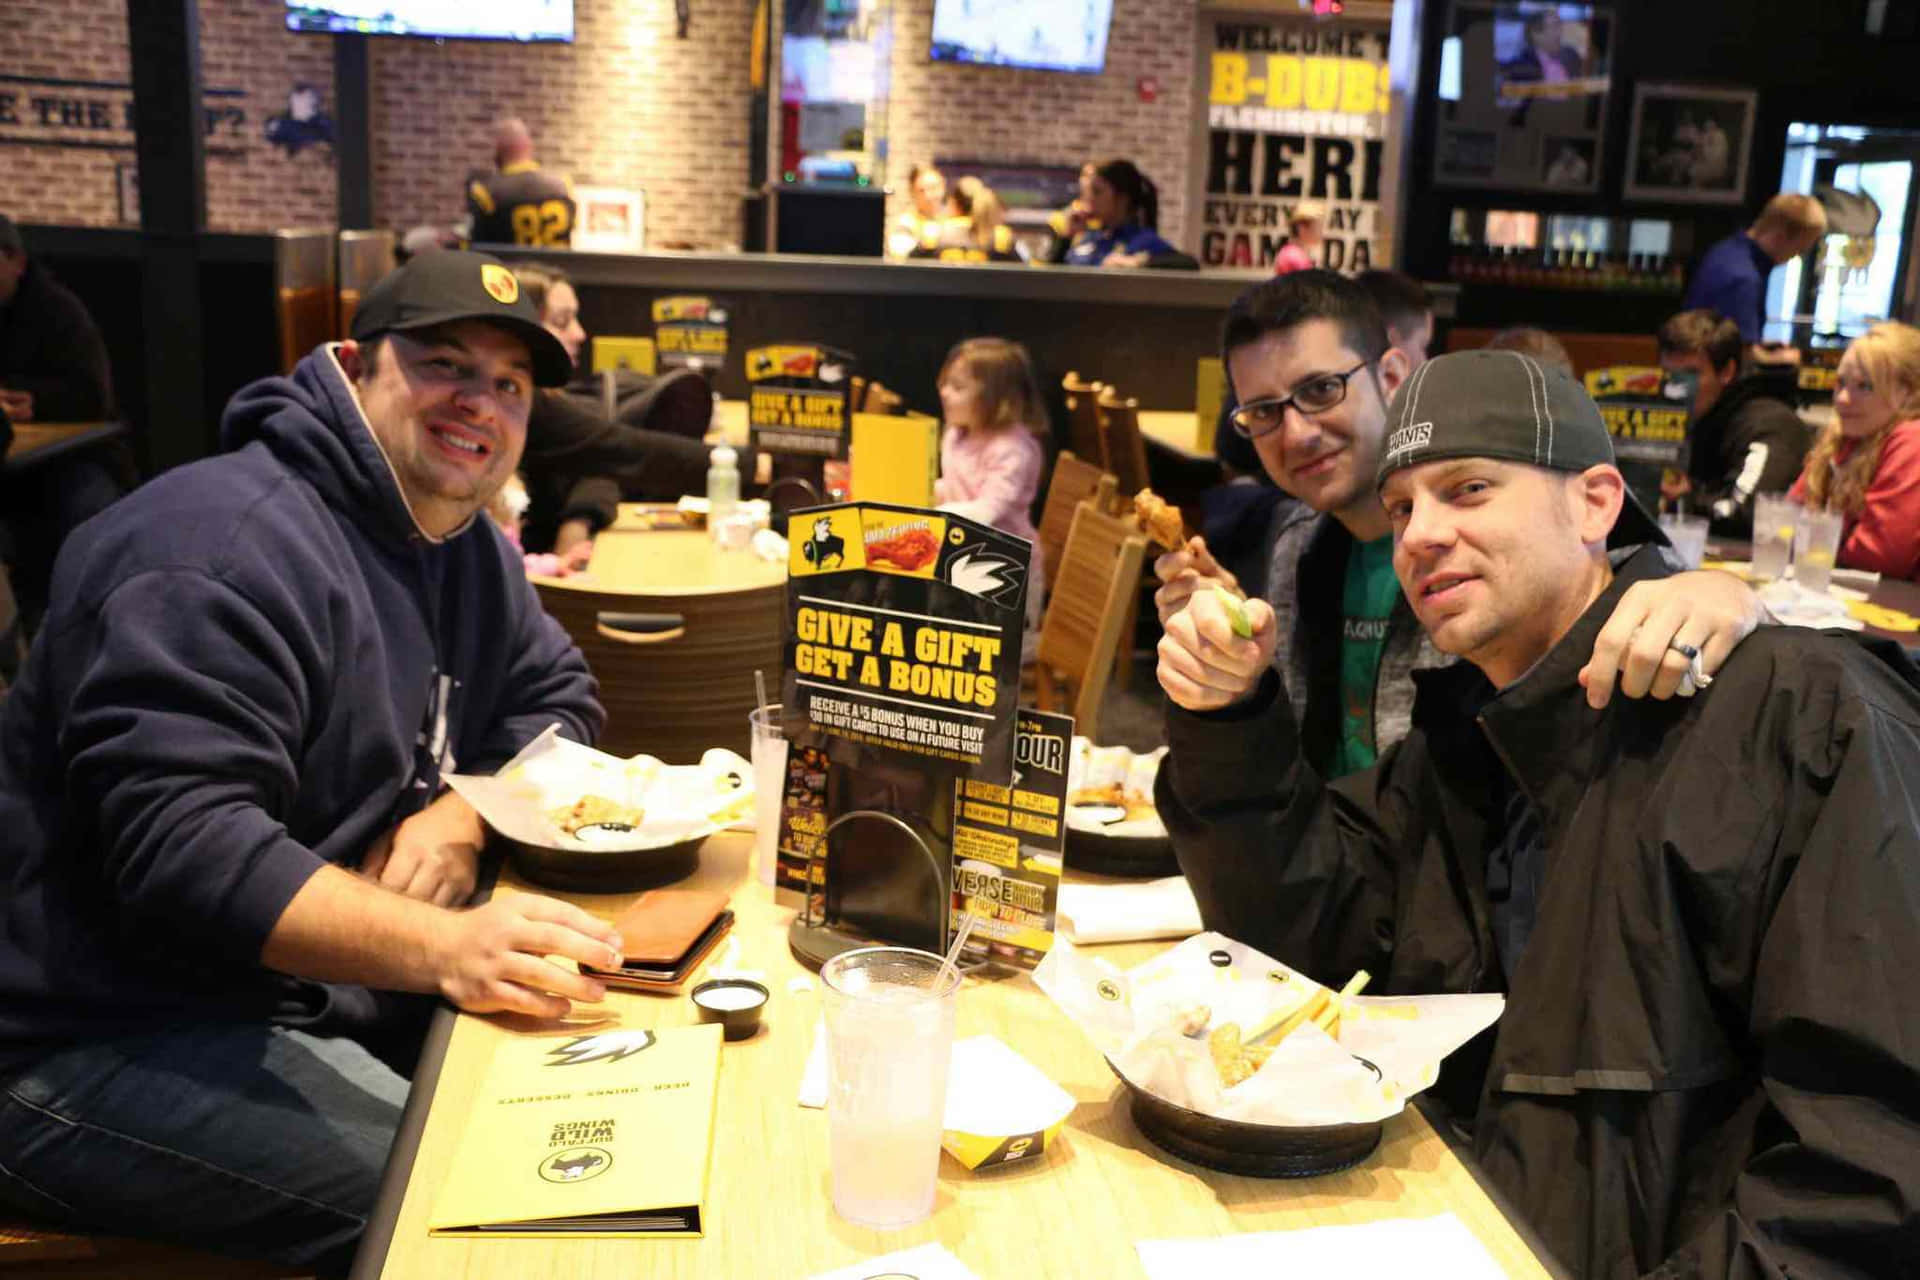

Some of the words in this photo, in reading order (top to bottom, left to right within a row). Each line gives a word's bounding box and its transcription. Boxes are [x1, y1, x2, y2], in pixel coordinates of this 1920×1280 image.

[1215, 22, 1366, 58] WELCOME
[797, 607, 874, 652] GIVE
[881, 622, 905, 658] A
[915, 627, 1000, 673] GIFT
[795, 643, 853, 681] GET
[859, 656, 881, 687] A
[889, 660, 997, 708] BONUS
[810, 695, 852, 717] RECEIVE
[851, 704, 860, 717] A
[859, 705, 871, 721] $5
[870, 706, 906, 728] BONUS
[906, 715, 938, 733] WHEN
[937, 720, 962, 738] YOU
[962, 725, 985, 742] BUY
[833, 714, 852, 730] GIFT
[852, 717, 878, 734] CARDS
[878, 722, 889, 736] TO
[889, 724, 907, 740] USE
[907, 728, 919, 742] ON
[919, 730, 926, 743] A
[926, 731, 960, 750] FUTURE
[960, 738, 984, 755] VISIT
[1016, 732, 1064, 776] OUR
[952, 865, 1013, 904] VERSE
[548, 1136, 614, 1149] BUFFALO
[550, 1127, 613, 1142] WILD
[553, 1118, 616, 1131] WINGS
